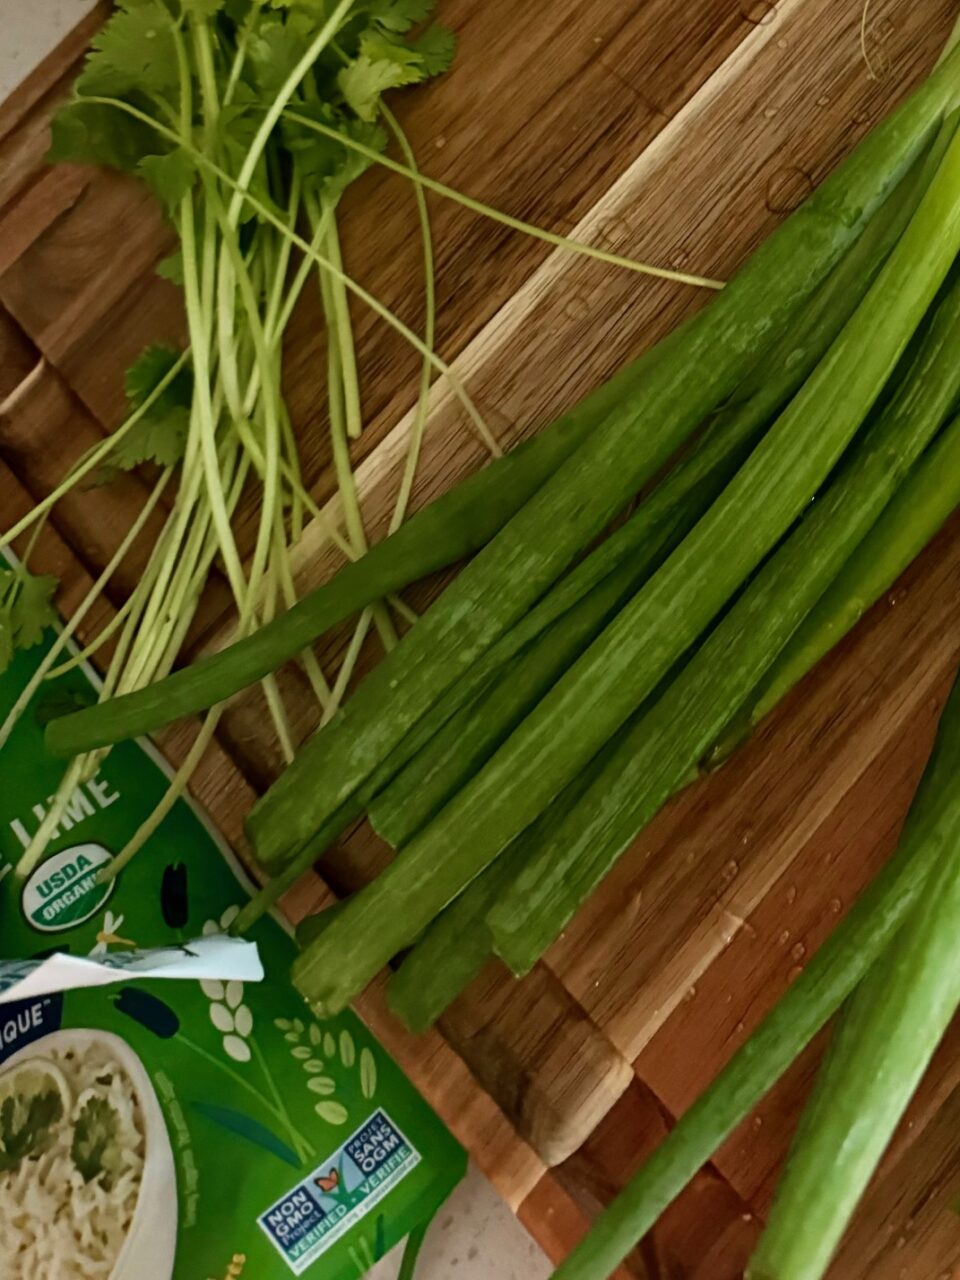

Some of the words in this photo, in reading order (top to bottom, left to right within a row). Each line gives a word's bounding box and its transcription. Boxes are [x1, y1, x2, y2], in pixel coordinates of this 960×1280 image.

[35, 853, 92, 899] USDA
[347, 1114, 384, 1154] PROJET
[352, 1122, 391, 1162] SANS
[360, 1133, 399, 1172] OGM
[267, 1190, 307, 1227] NON
[274, 1199, 315, 1237] GMO
[281, 1208, 321, 1246] Project
[288, 1202, 348, 1257] VERIFIED
